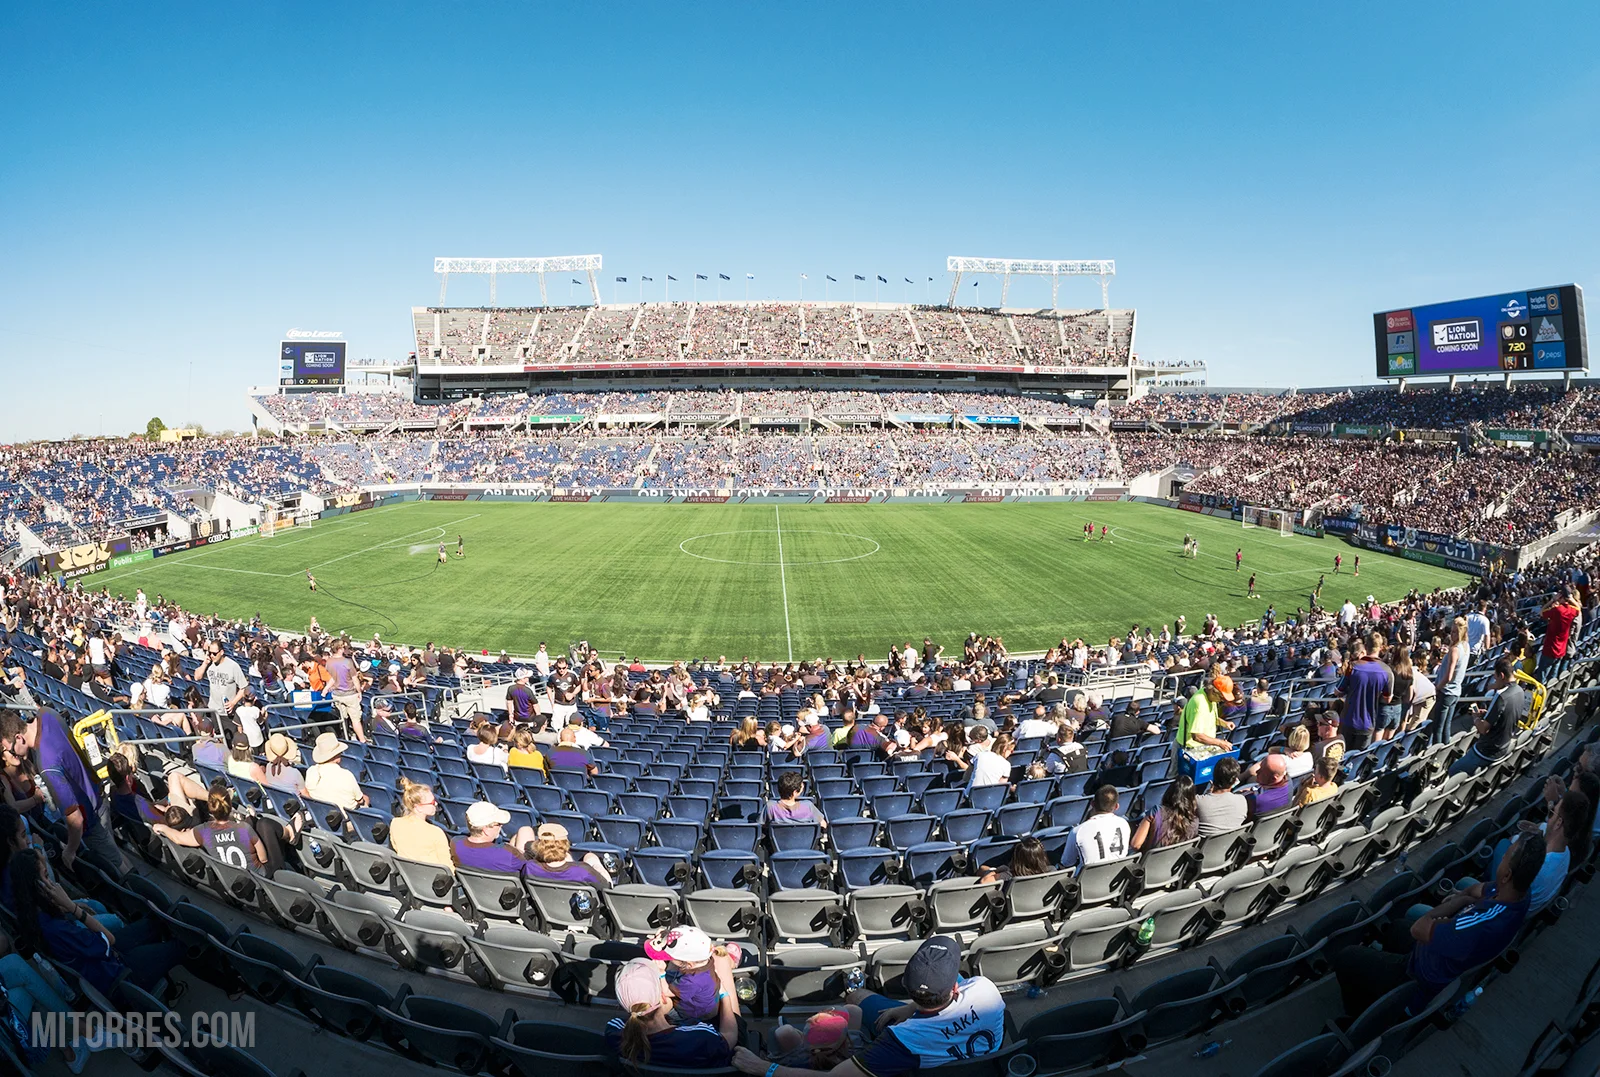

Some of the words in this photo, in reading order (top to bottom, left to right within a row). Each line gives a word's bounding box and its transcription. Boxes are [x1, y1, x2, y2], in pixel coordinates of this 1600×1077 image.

[1448, 325, 1466, 333] LION
[1519, 326, 1527, 337] 0
[1448, 332, 1476, 341] NATION
[1437, 345, 1460, 353] COMING
[1461, 343, 1479, 351] SOON
[1508, 342, 1526, 352] 7:20
[1546, 351, 1562, 359] pepsi
[1523, 357, 1527, 368] 1
[1500, 432, 1528, 440] Heineken
[1405, 550, 1422, 560] Publix
[114, 556, 132, 566] Publix
[1446, 560, 1470, 571] ORLANDO
[66, 568, 88, 578] ORLANDO
[96, 562, 106, 571] CITY
[208, 670, 229, 680] ORLANDO
[900, 754, 918, 762] TURNER
[215, 831, 236, 843] KAKÁ
[1094, 827, 1124, 860] 14
[216, 846, 248, 870] 10
[940, 1005, 980, 1040] KAKÁ
